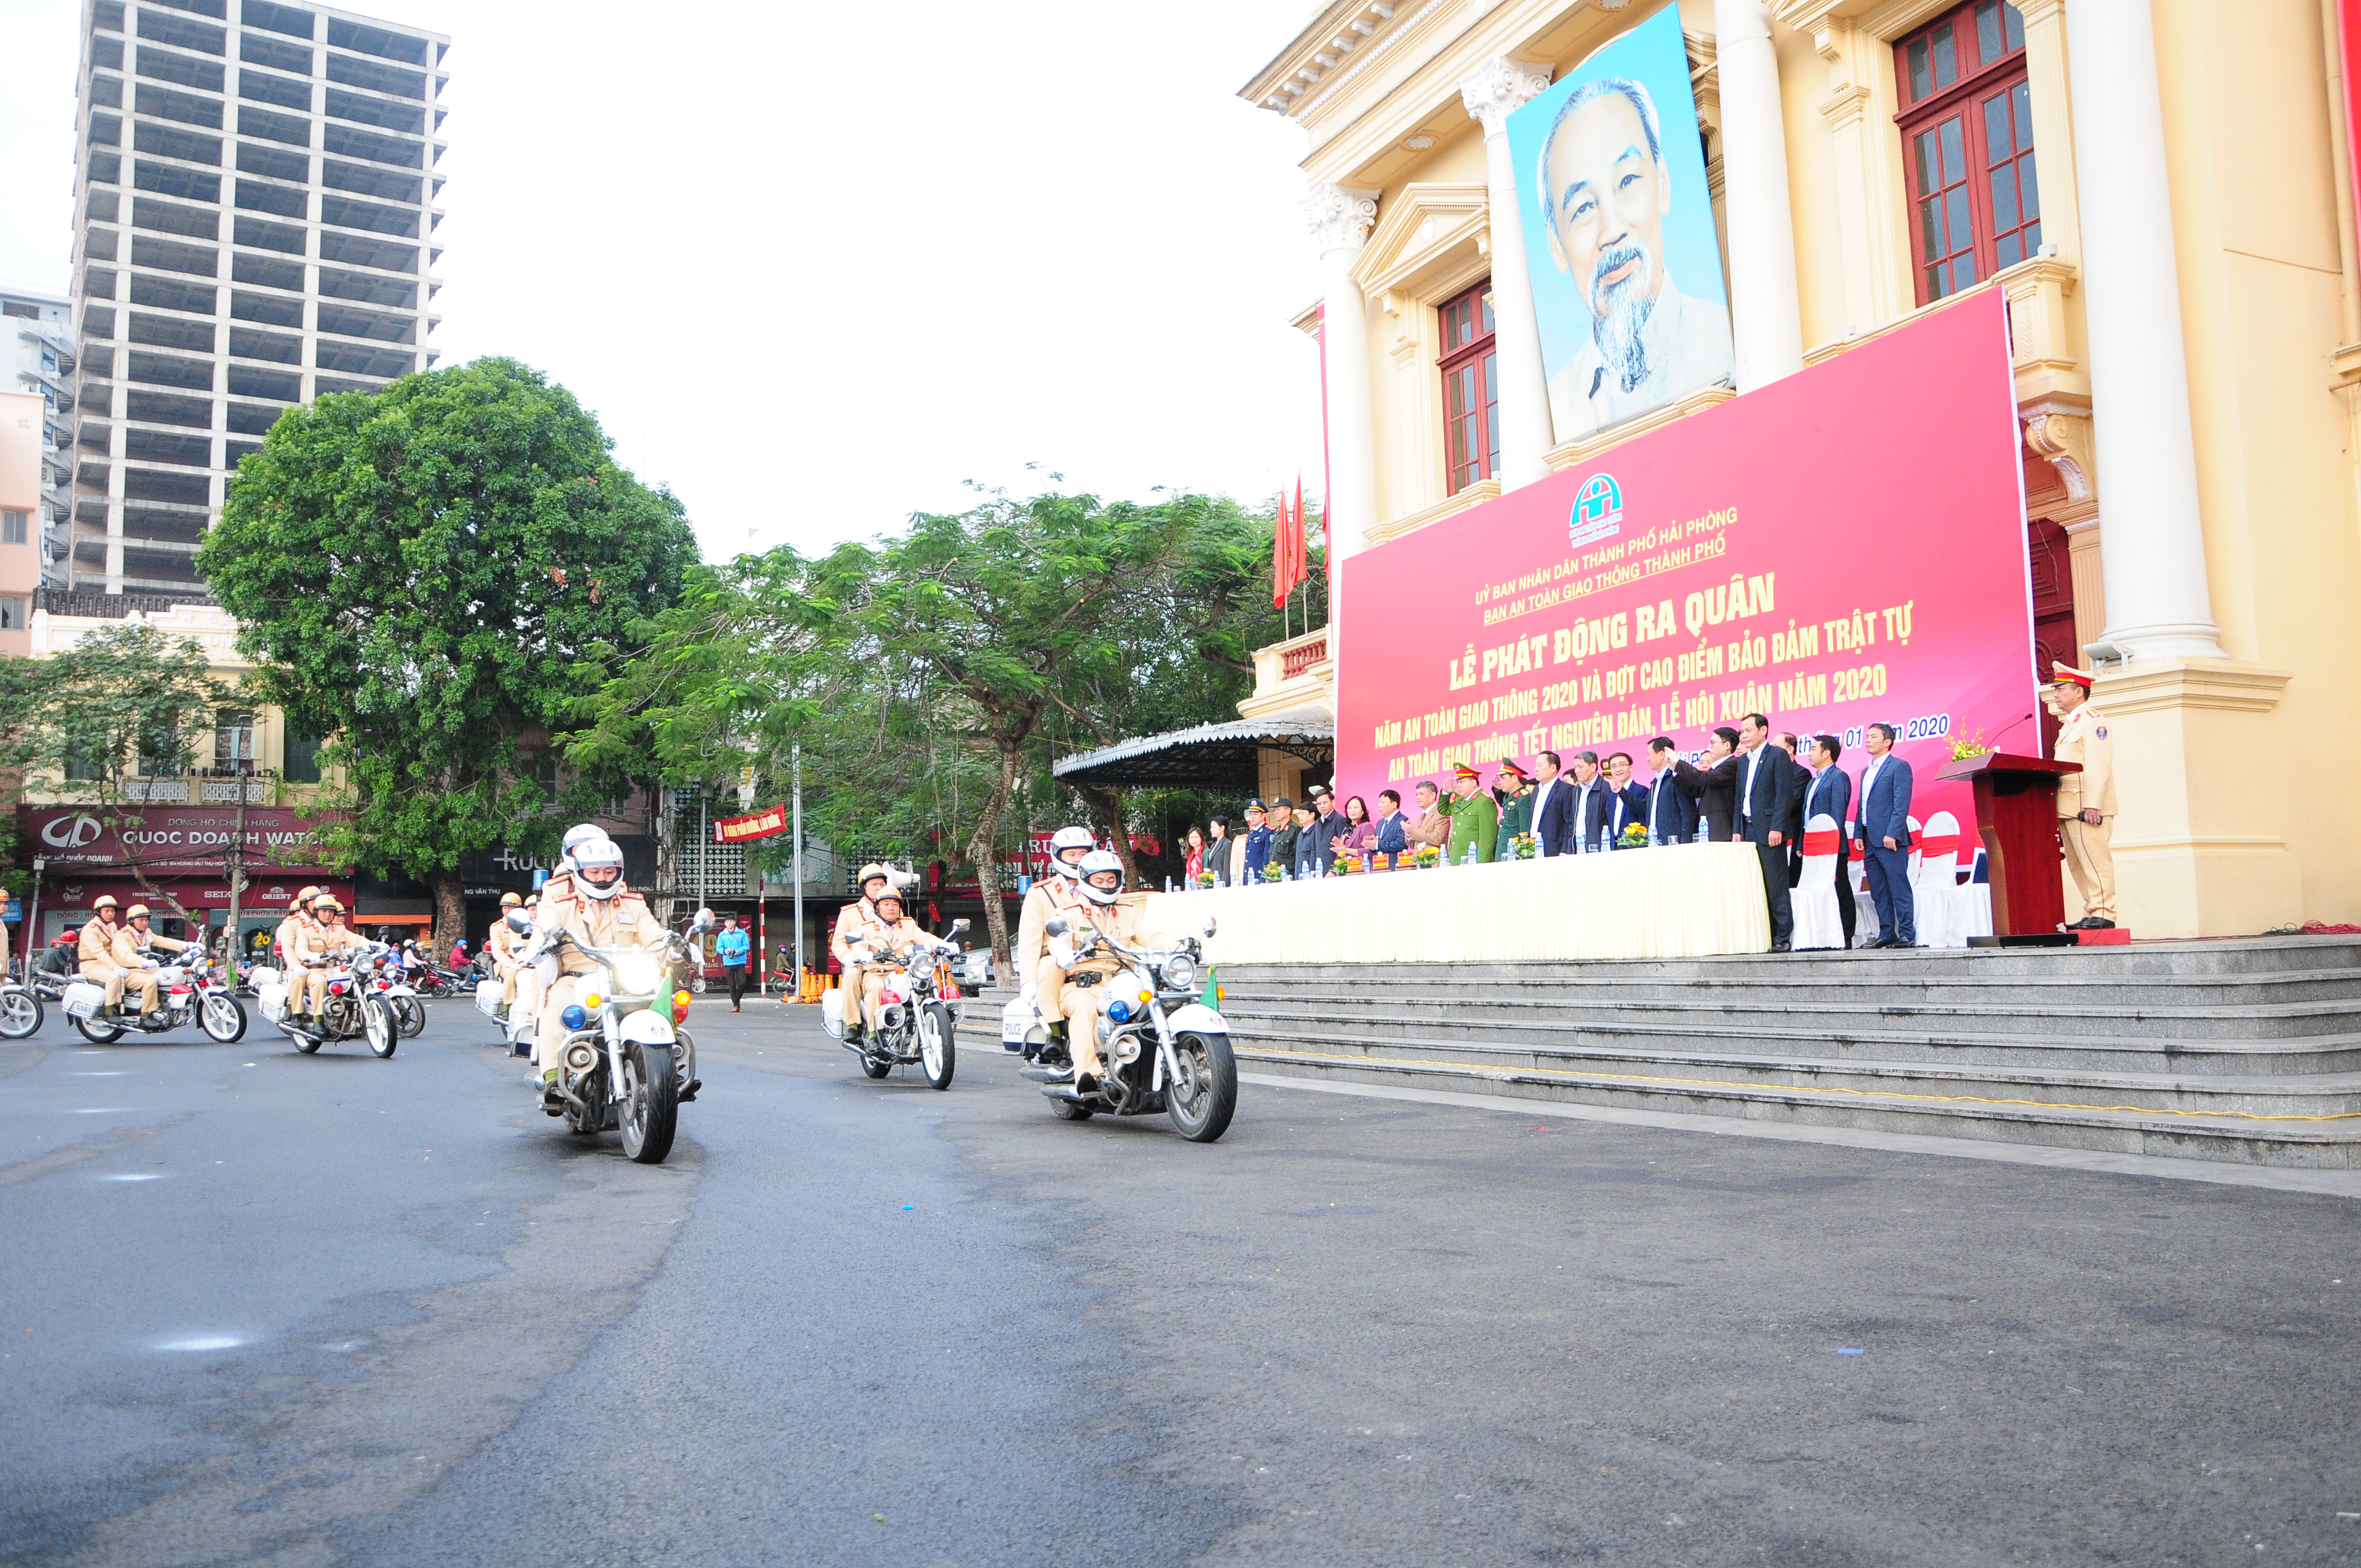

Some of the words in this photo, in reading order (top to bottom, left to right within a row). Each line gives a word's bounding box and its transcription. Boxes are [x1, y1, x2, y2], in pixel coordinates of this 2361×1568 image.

[1476, 584, 1489, 605] UỶ
[1493, 580, 1515, 600] BAN
[1519, 568, 1551, 591] NHÂN
[1554, 558, 1579, 580] DÂN
[1582, 543, 1624, 570] THÀNH
[1628, 526, 1656, 556] PHỐ
[1660, 520, 1682, 546] HẢI
[1687, 507, 1737, 537] PHÒNG
[1484, 605, 1506, 624] BAN
[1509, 599, 1525, 616] AN
[1528, 587, 1559, 609] TOÀN
[1563, 578, 1592, 600] GIAO
[1595, 562, 1640, 589] THÔNG
[1643, 549, 1690, 574] THÀNH
[1695, 529, 1726, 559] PHỐ
[1375, 719, 1401, 749] NĂM
[1403, 716, 1421, 743] AN
[1424, 706, 1456, 738] TOÀN
[1459, 700, 1489, 730] GIAO
[1492, 688, 1538, 722] THÔNG
[1541, 679, 1578, 712] 2020
[1581, 668, 1602, 703] VÀ
[1605, 664, 1636, 701] ĐỢT
[1640, 657, 1673, 690] CAO
[1677, 637, 1723, 683] ĐIỂM
[1728, 629, 1766, 673] BẢO
[1771, 619, 1818, 663] ĐẢM
[1823, 608, 1877, 655] TRẬT
[1883, 600, 1913, 645] TỰ
[1449, 643, 1476, 692] LỄ
[1482, 633, 1548, 683] PHÁT
[1553, 611, 1628, 666] ĐỘNG
[1635, 599, 1677, 644] RA
[1685, 571, 1775, 638] QUÂN
[1388, 757, 1405, 782] AN
[1407, 747, 1439, 778] TOÀN
[1442, 743, 1471, 771] GIAO
[1474, 732, 1519, 765] THÔNG
[1522, 720, 1548, 756] TẾT
[1552, 711, 1613, 752] NGUYÊN
[1617, 703, 1656, 737] ĐÁN,
[1661, 690, 1680, 732] LỄ
[1685, 690, 1715, 732] HỘI
[1720, 680, 1772, 722] XUÂN
[1778, 671, 1826, 712] NĂM
[1833, 663, 1886, 703] 2020
[1846, 729, 1862, 747] 01
[1908, 715, 1947, 738] 2020
[123, 831, 182, 844] QUOC
[77, 1004, 91, 1012] CSGT
[1005, 1023, 1020, 1035] POLICE
